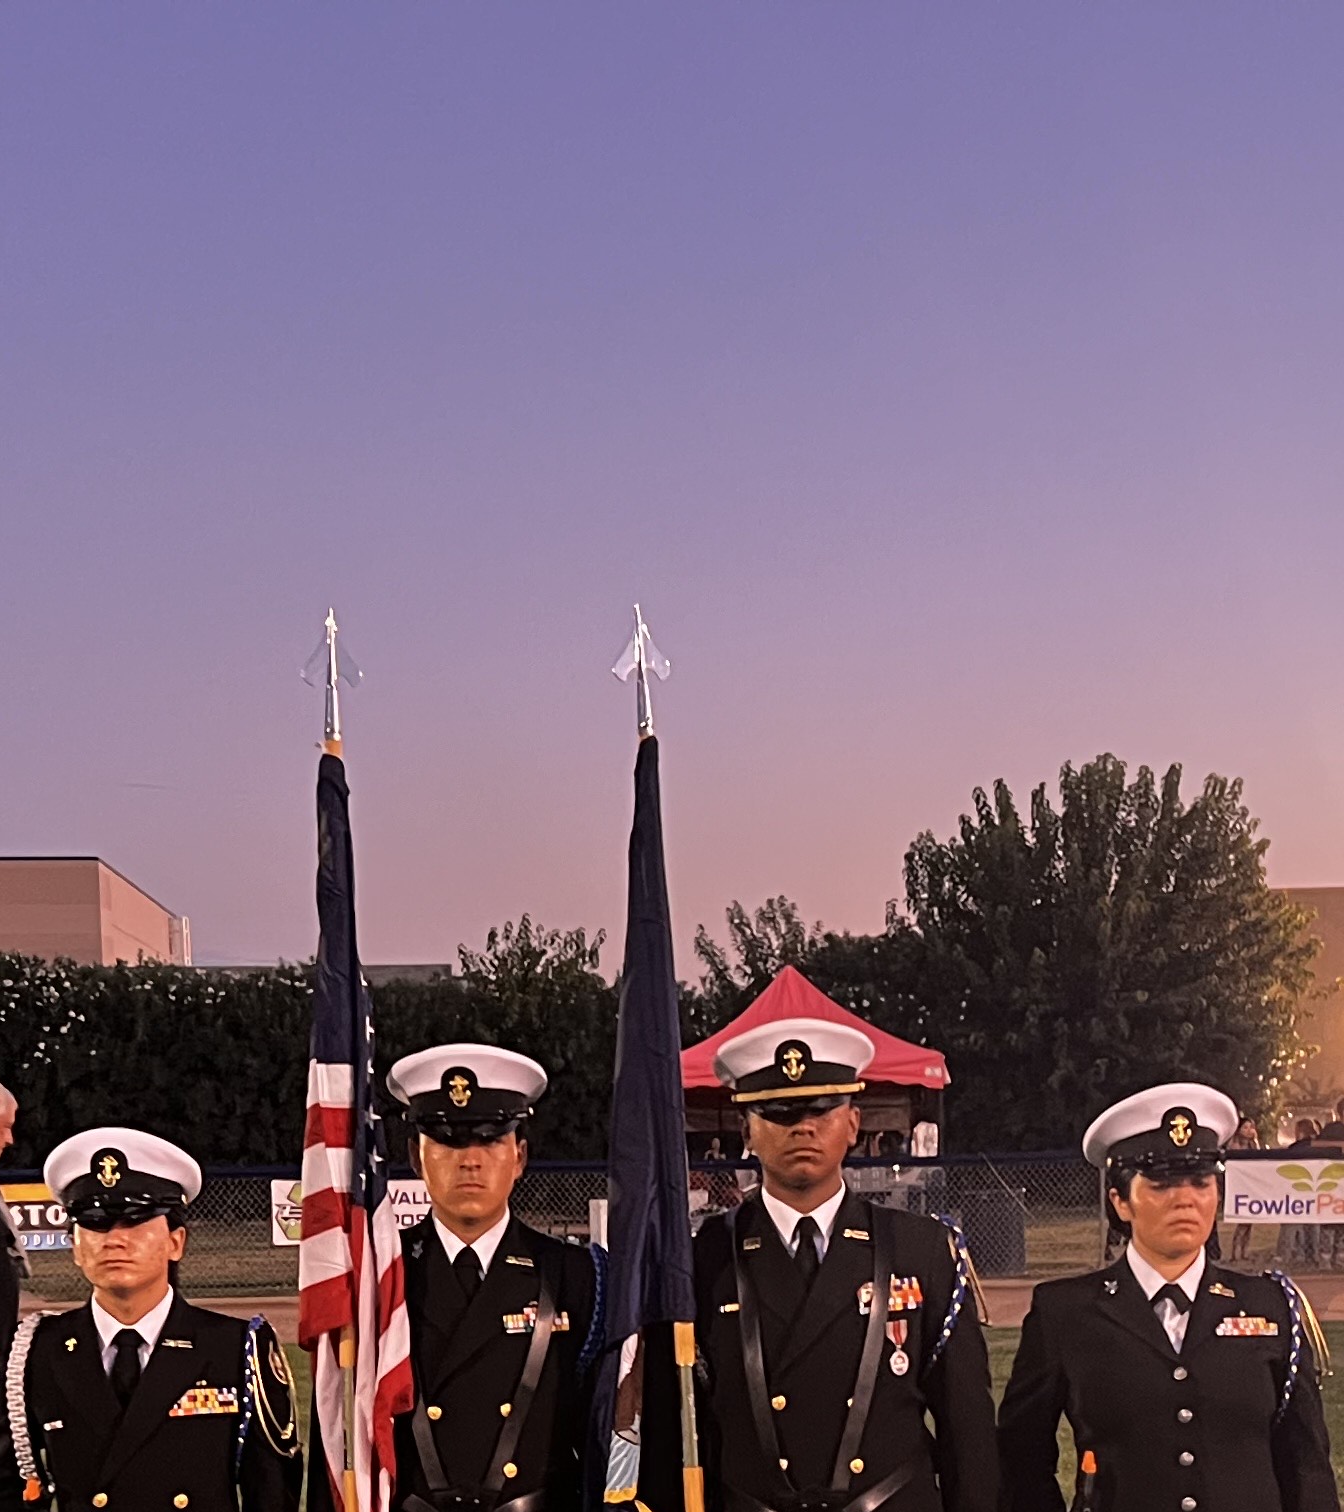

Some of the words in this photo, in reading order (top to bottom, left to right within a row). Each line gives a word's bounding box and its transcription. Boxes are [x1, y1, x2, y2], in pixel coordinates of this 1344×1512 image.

[389, 1189, 432, 1205] VALL
[9, 1204, 68, 1226] STO
[20, 1234, 67, 1246] ODUC
